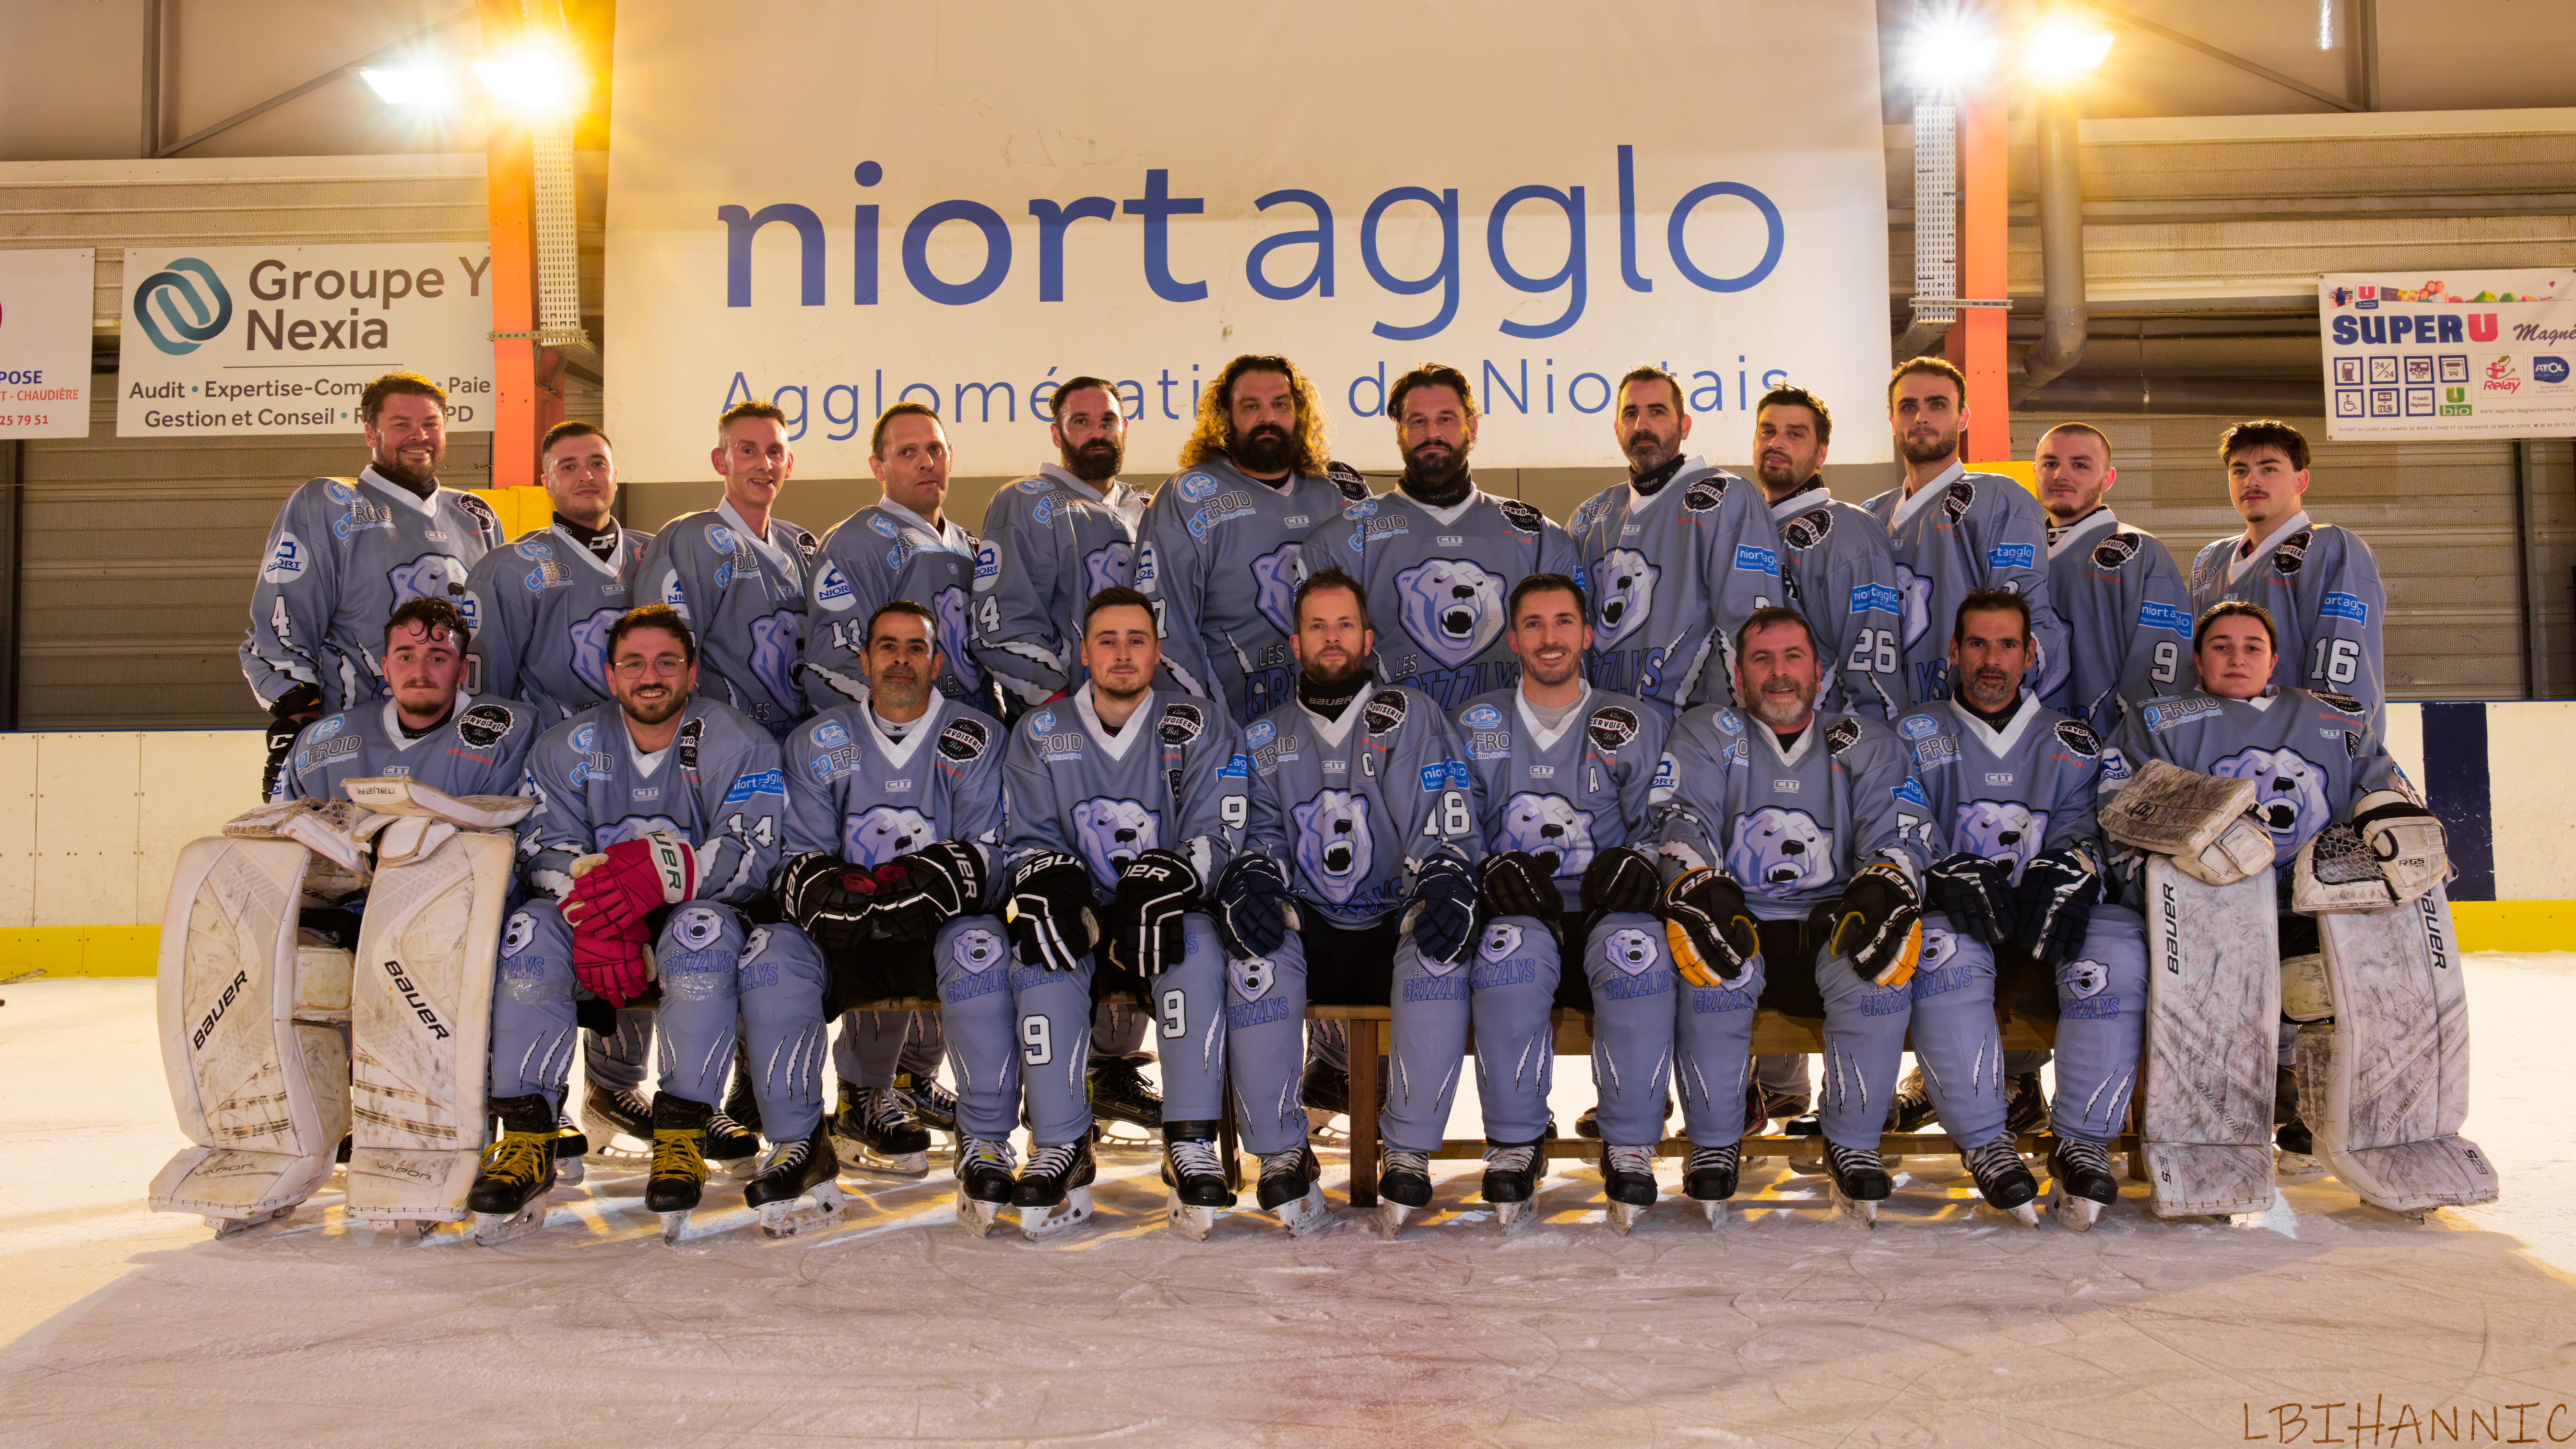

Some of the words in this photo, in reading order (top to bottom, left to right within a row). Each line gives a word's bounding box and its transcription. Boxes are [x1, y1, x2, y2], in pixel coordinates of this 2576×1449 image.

[248, 259, 445, 310] Groupe
[458, 256, 490, 296] Y
[247, 309, 388, 351] Nexia
[2332, 315, 2463, 345] SUPER
[2468, 313, 2498, 342] U
[2535, 363, 2564, 373] ATOL
[17, 388, 79, 401] CHAUDIÈRE
[129, 381, 186, 399] Audit
[205, 378, 366, 401] Expertise-Com
[449, 377, 490, 393] Paie
[2483, 380, 2520, 394] Relay
[719, 365, 1199, 441] Aggloméati
[2443, 406, 2470, 415] bio
[17, 415, 31, 425] 79
[35, 415, 48, 425] 51
[145, 410, 226, 428] Gestion
[232, 412, 252, 427] et
[258, 407, 334, 427] Conseil
[267, 560, 301, 570] NIORT
[819, 585, 849, 598] NIOR
[270, 595, 291, 637] 4
[831, 617, 862, 649] 11
[1259, 644, 1285, 667] LES
[1395, 653, 1418, 676] LES
[1847, 628, 1896, 674] 26
[2151, 640, 2178, 684] 9
[2310, 637, 2361, 685] 16
[748, 703, 770, 719] LES
[1361, 752, 1375, 777] C
[1588, 766, 1600, 794] A
[1220, 794, 1247, 830] 9
[1423, 790, 1471, 836] 18
[727, 813, 775, 848] 14
[665, 950, 732, 982] GRIZZLYS
[952, 970, 962, 981] LES
[1411, 968, 1422, 979] LES
[1607, 970, 1618, 980] LES
[1403, 977, 1467, 1002] GRIZZLYS
[1604, 970, 1669, 1001] GRIZZLYS
[1869, 985, 1883, 995] LES
[1912, 966, 1972, 1001] RIZZLYS
[193, 970, 248, 1051] BAUER
[384, 961, 450, 1041] BAUER
[1162, 989, 1186, 1039] 9
[1229, 997, 1289, 1030] GRIZZLYS
[1022, 1014, 1052, 1066] 9
[610, 1110, 635, 1127] BAUER
[378, 1162, 432, 1179] VAPOR
